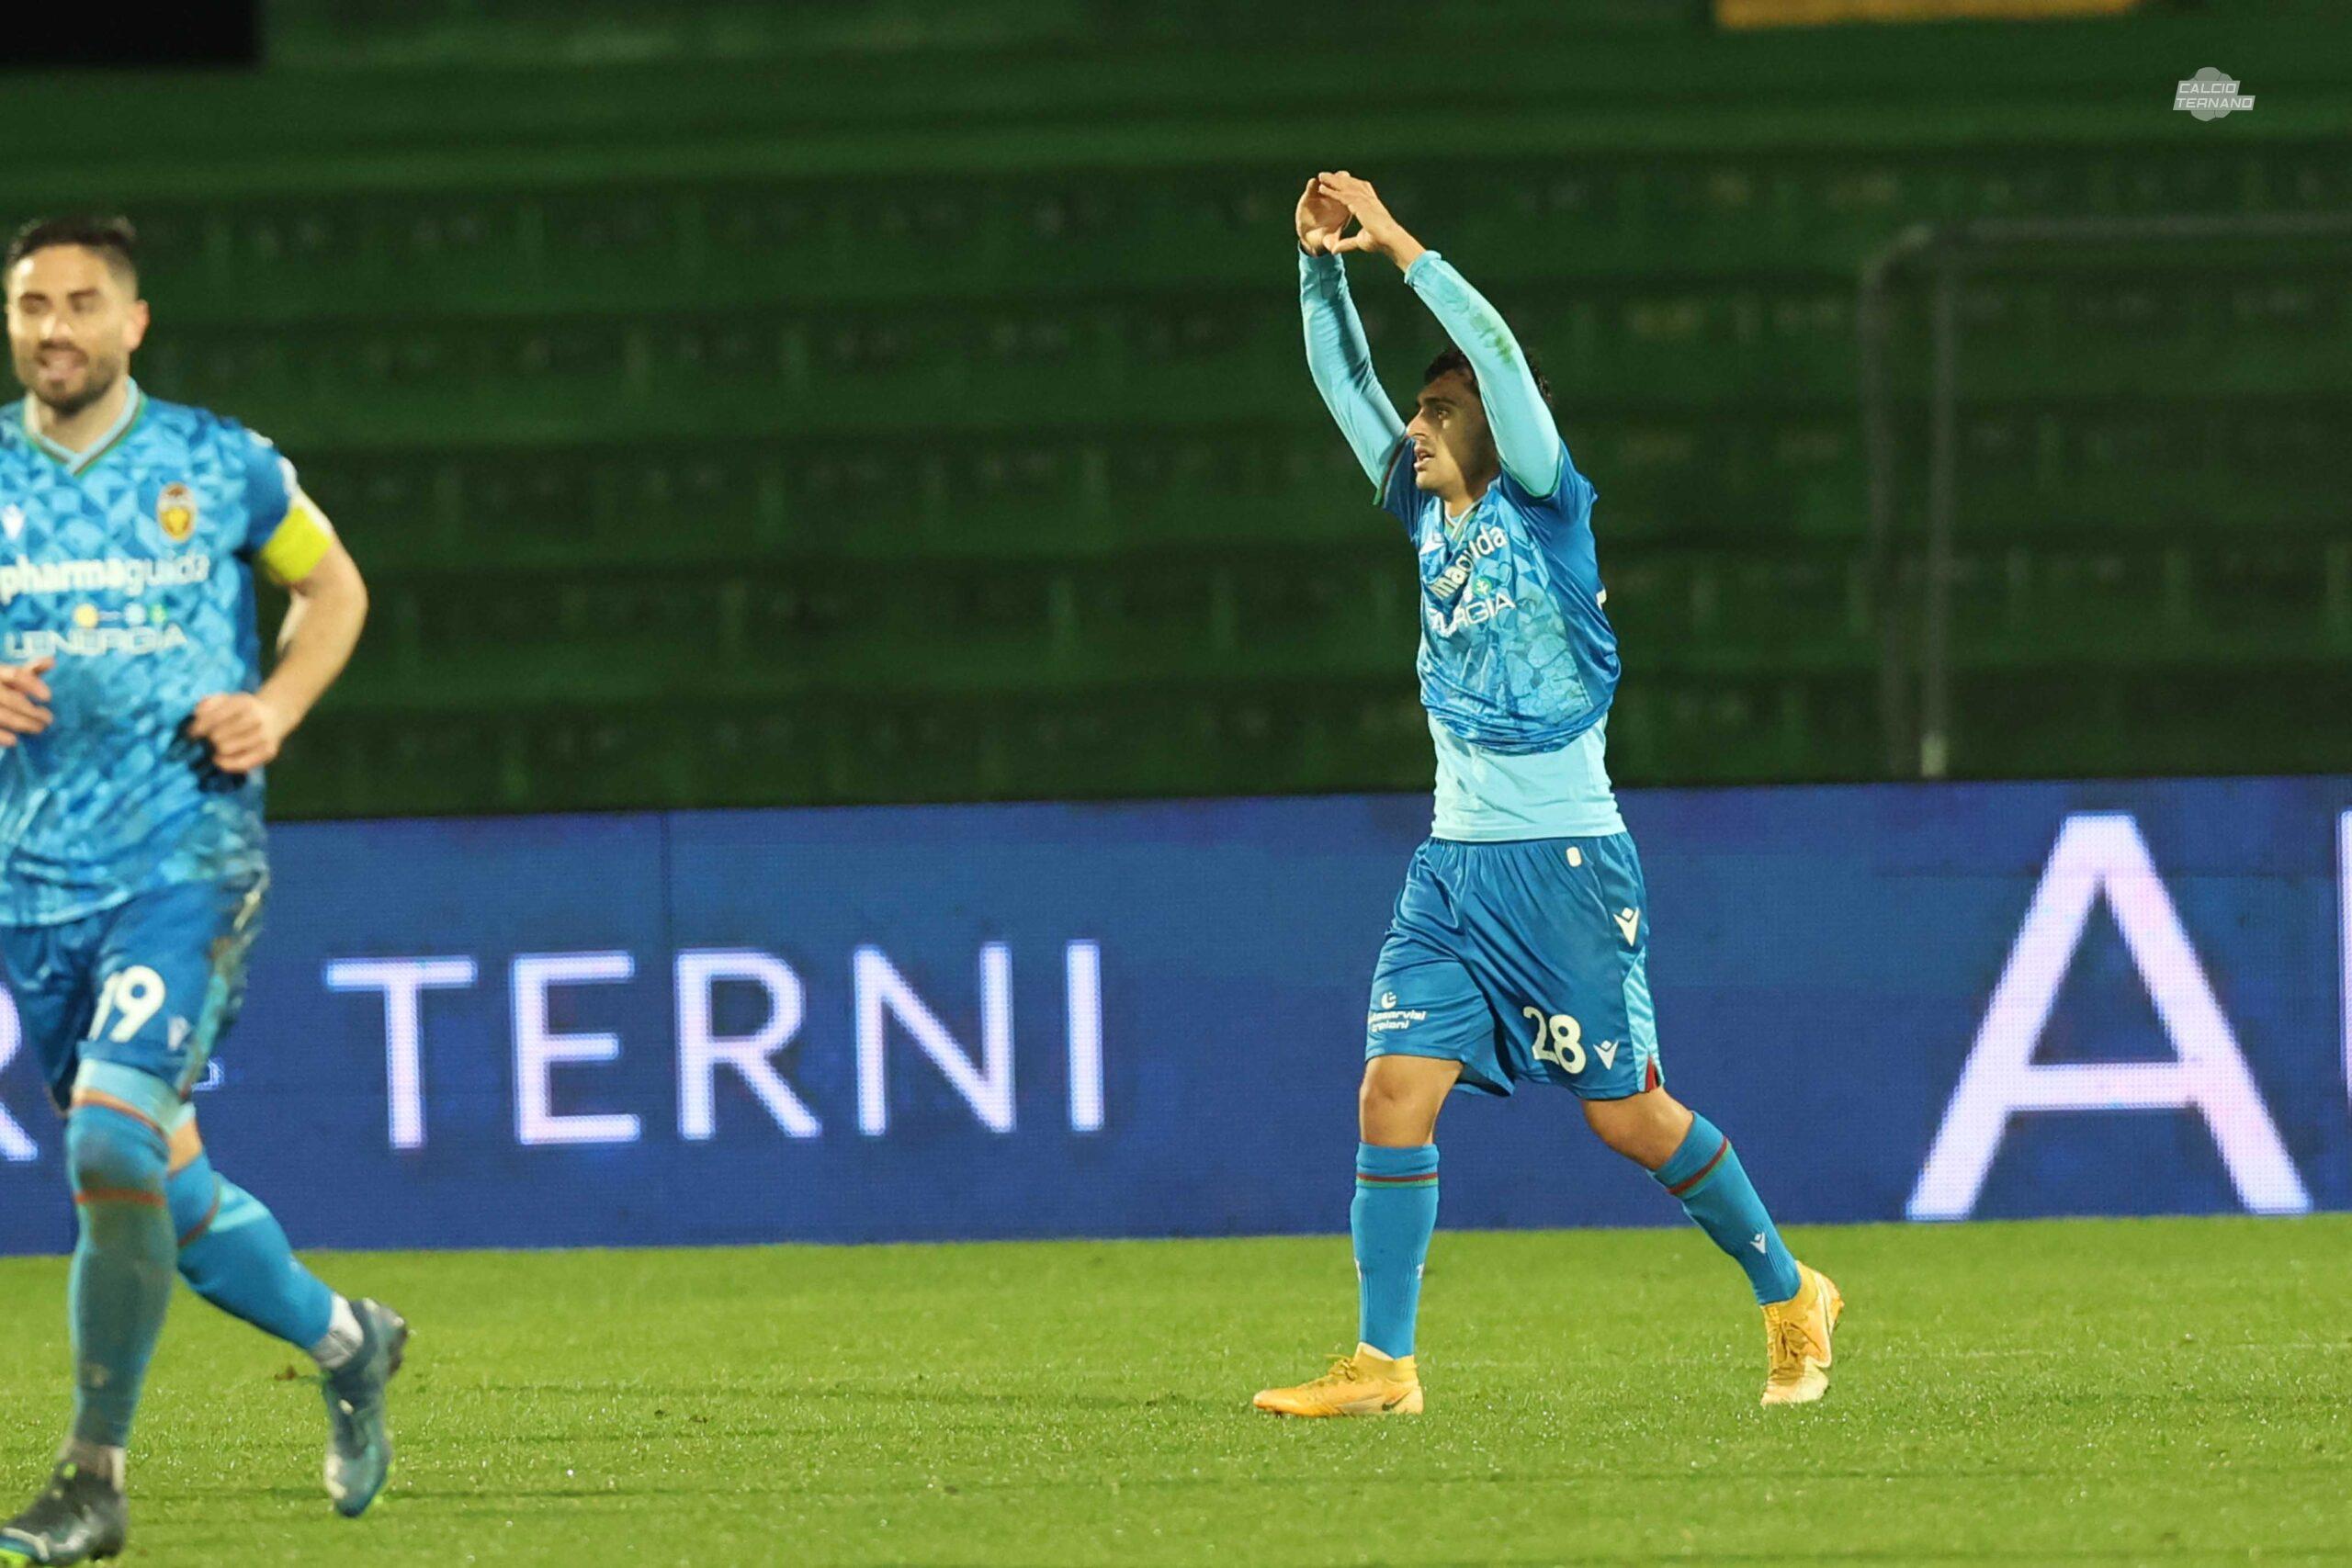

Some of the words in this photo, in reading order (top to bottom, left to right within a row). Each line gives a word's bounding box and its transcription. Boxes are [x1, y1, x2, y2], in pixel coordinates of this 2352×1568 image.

[88, 964, 166, 1043] 19
[324, 939, 1104, 1151] TERNI
[1522, 1006, 1587, 1075] 28
[1905, 810, 2352, 1221] A
